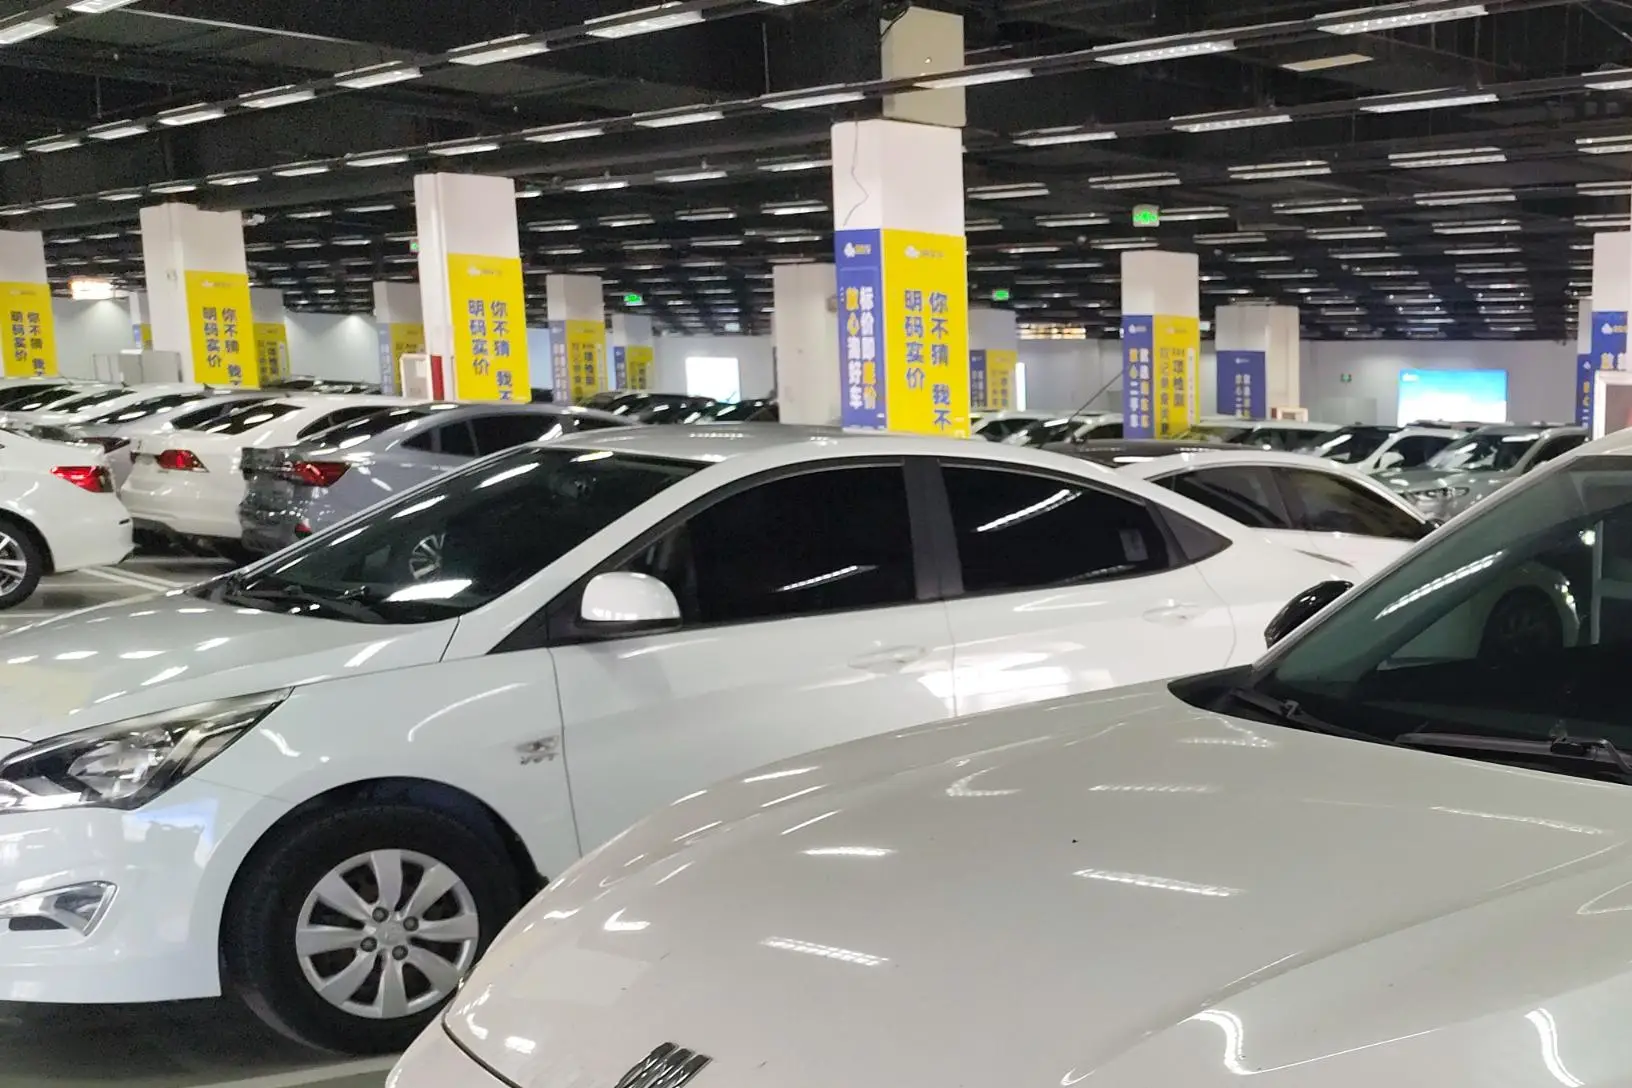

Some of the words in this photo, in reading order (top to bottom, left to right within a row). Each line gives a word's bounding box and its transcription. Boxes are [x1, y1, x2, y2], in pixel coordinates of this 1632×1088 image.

[904, 289, 925, 392] 明码实价
[929, 291, 949, 367] 你不猜
